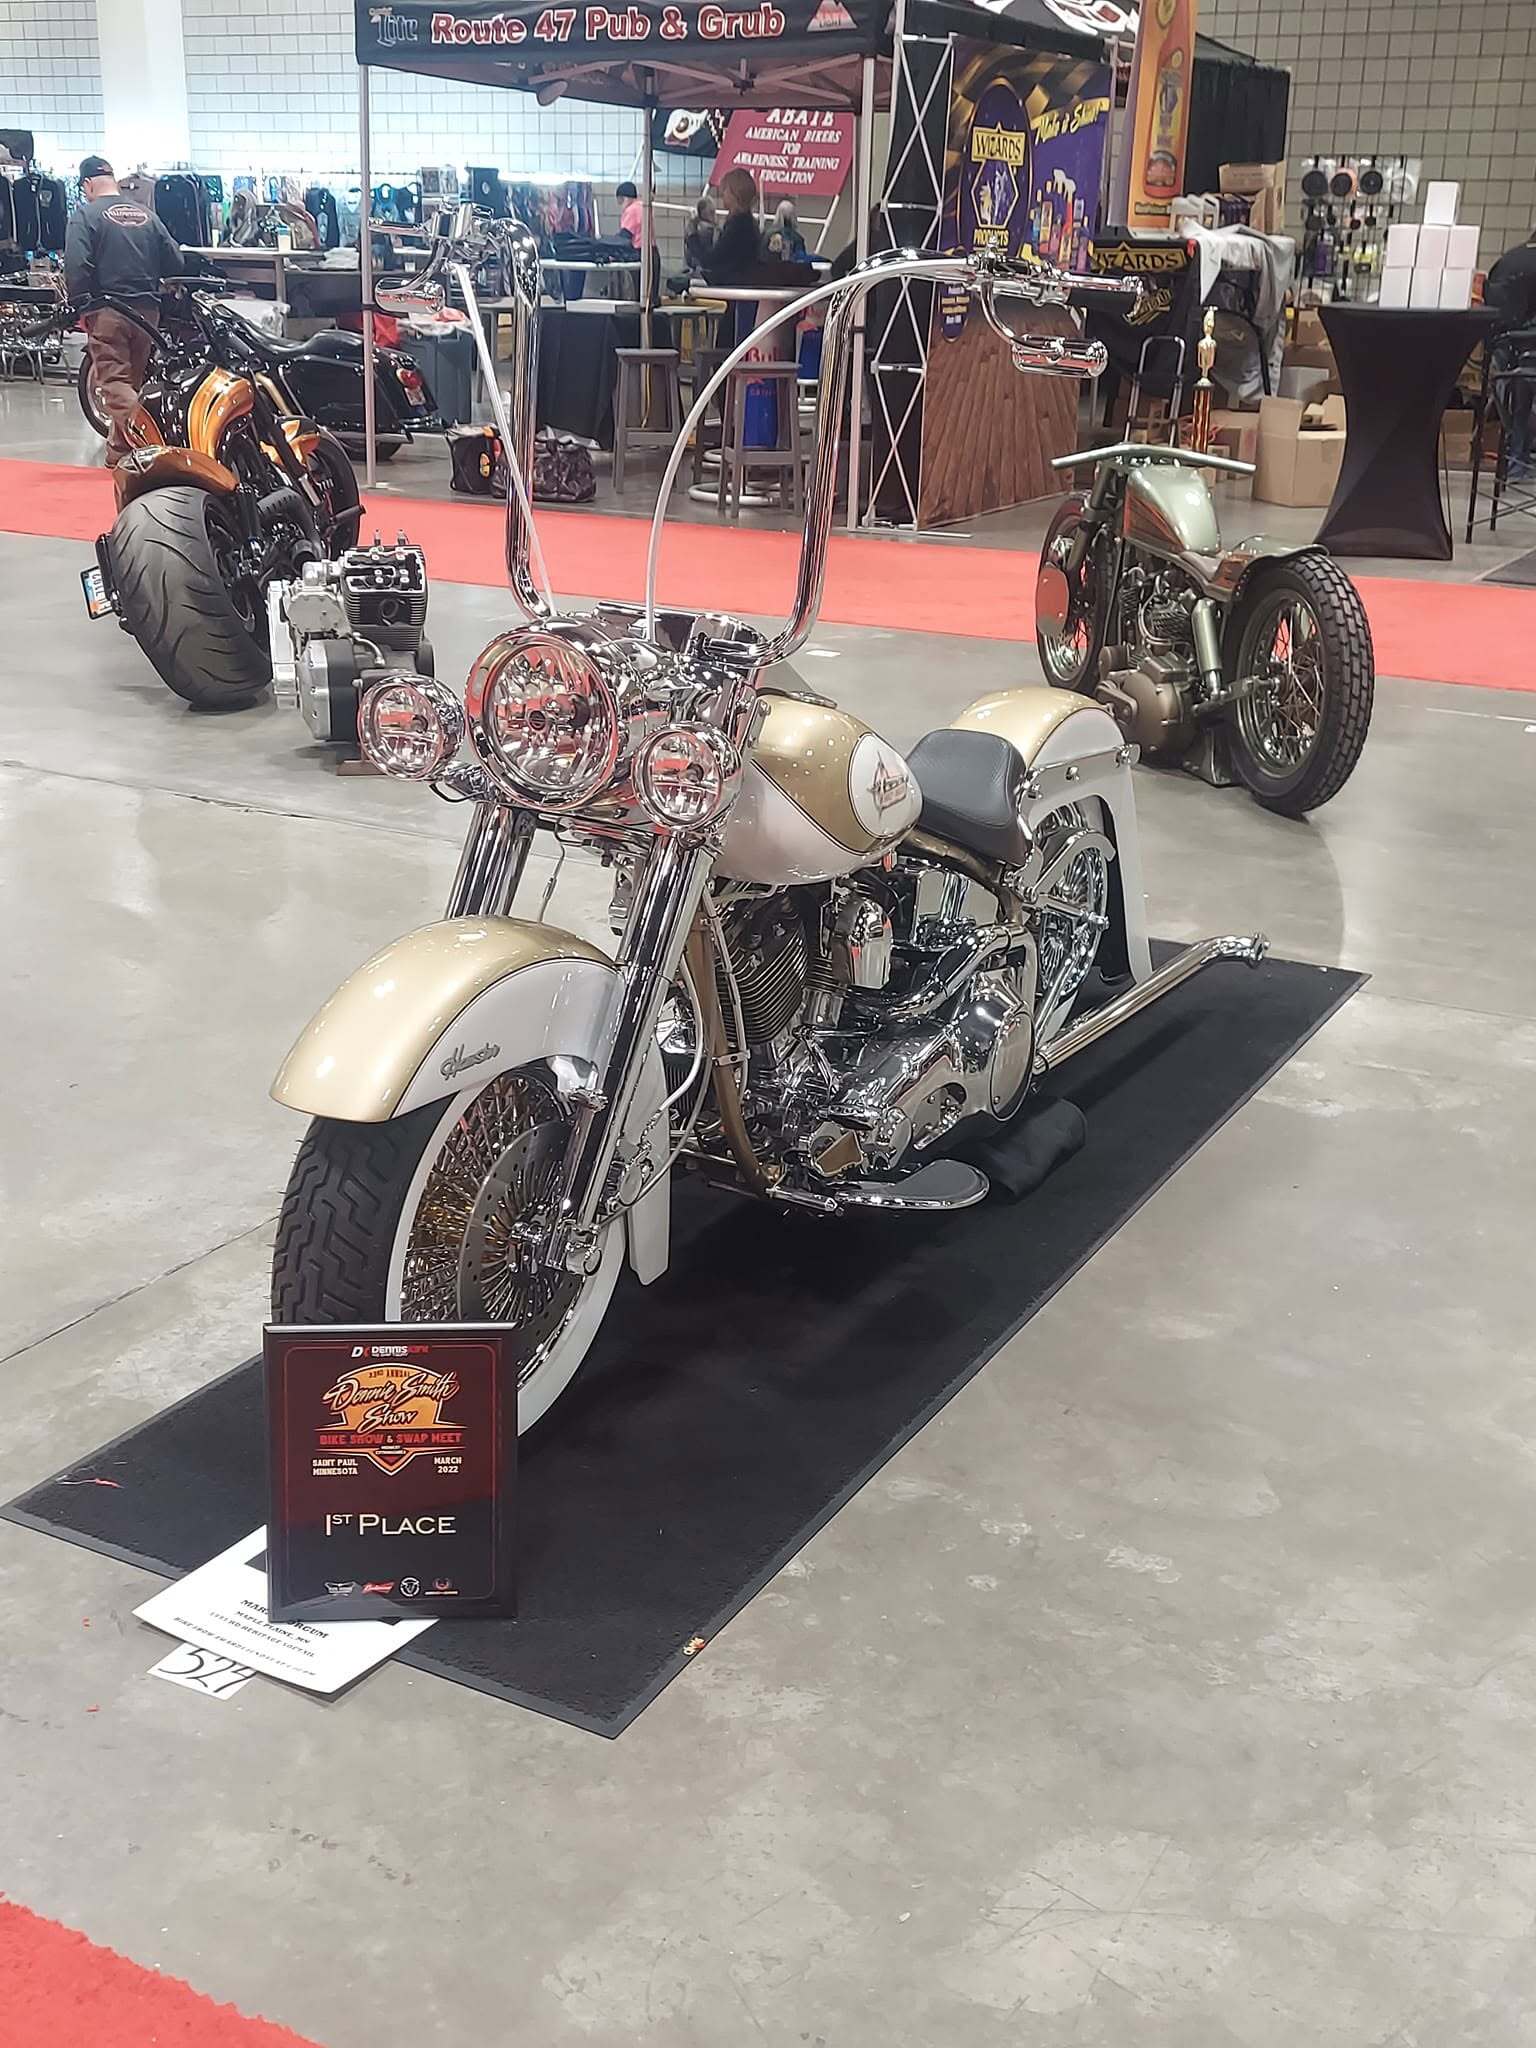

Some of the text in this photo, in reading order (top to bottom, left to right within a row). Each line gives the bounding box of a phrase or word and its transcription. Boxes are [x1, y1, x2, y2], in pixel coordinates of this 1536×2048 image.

[431, 2, 785, 44] Route 47 Pub & Grub
[744, 127, 842, 143] AMERICAN BIKERS
[781, 143, 801, 155] FOR
[976, 134, 1021, 159] WIZARDS
[792, 155, 840, 170] TRAINING
[758, 169, 815, 184] EDUCATION
[322, 1371, 460, 1416] Donnie Smith
[356, 1403, 418, 1435] Show
[319, 1433, 463, 1445] BIKE SHOW & SWAP MEET
[312, 1458, 358, 1467] SAINT PAUL
[434, 1457, 462, 1465] MARCH
[312, 1467, 358, 1475] MINNESOTA
[437, 1465, 459, 1473] 2022
[359, 1514, 457, 1535] PLACE
[240, 1600, 329, 1638] MAR ORGUM
